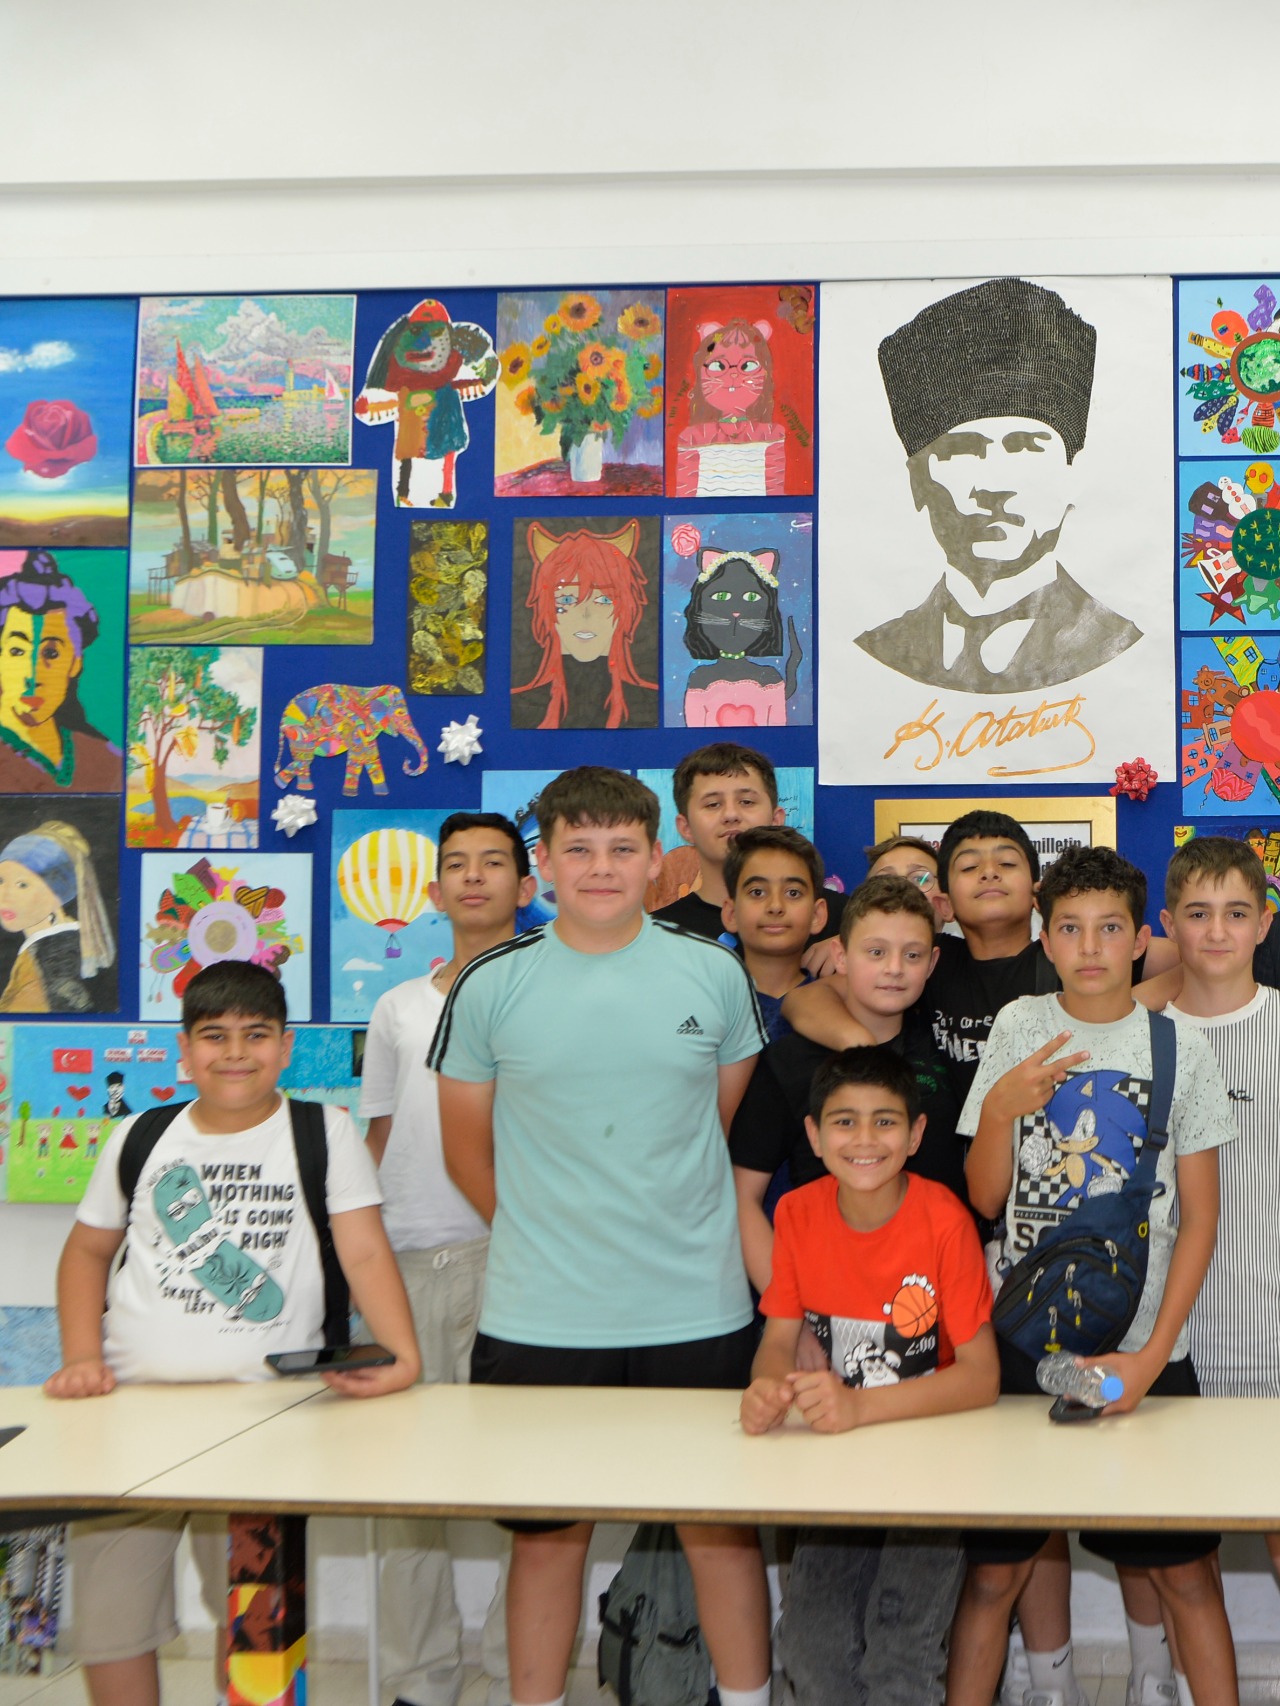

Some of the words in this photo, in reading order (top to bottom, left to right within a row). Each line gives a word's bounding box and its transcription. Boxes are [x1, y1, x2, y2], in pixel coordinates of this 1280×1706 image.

[676, 1028, 704, 1036] adidas
[201, 1164, 262, 1181] WHEN
[209, 1184, 295, 1202] NOTHING
[247, 1208, 294, 1226] GOING
[162, 1287, 204, 1301] SKATE
[184, 1302, 216, 1314] LEFT
